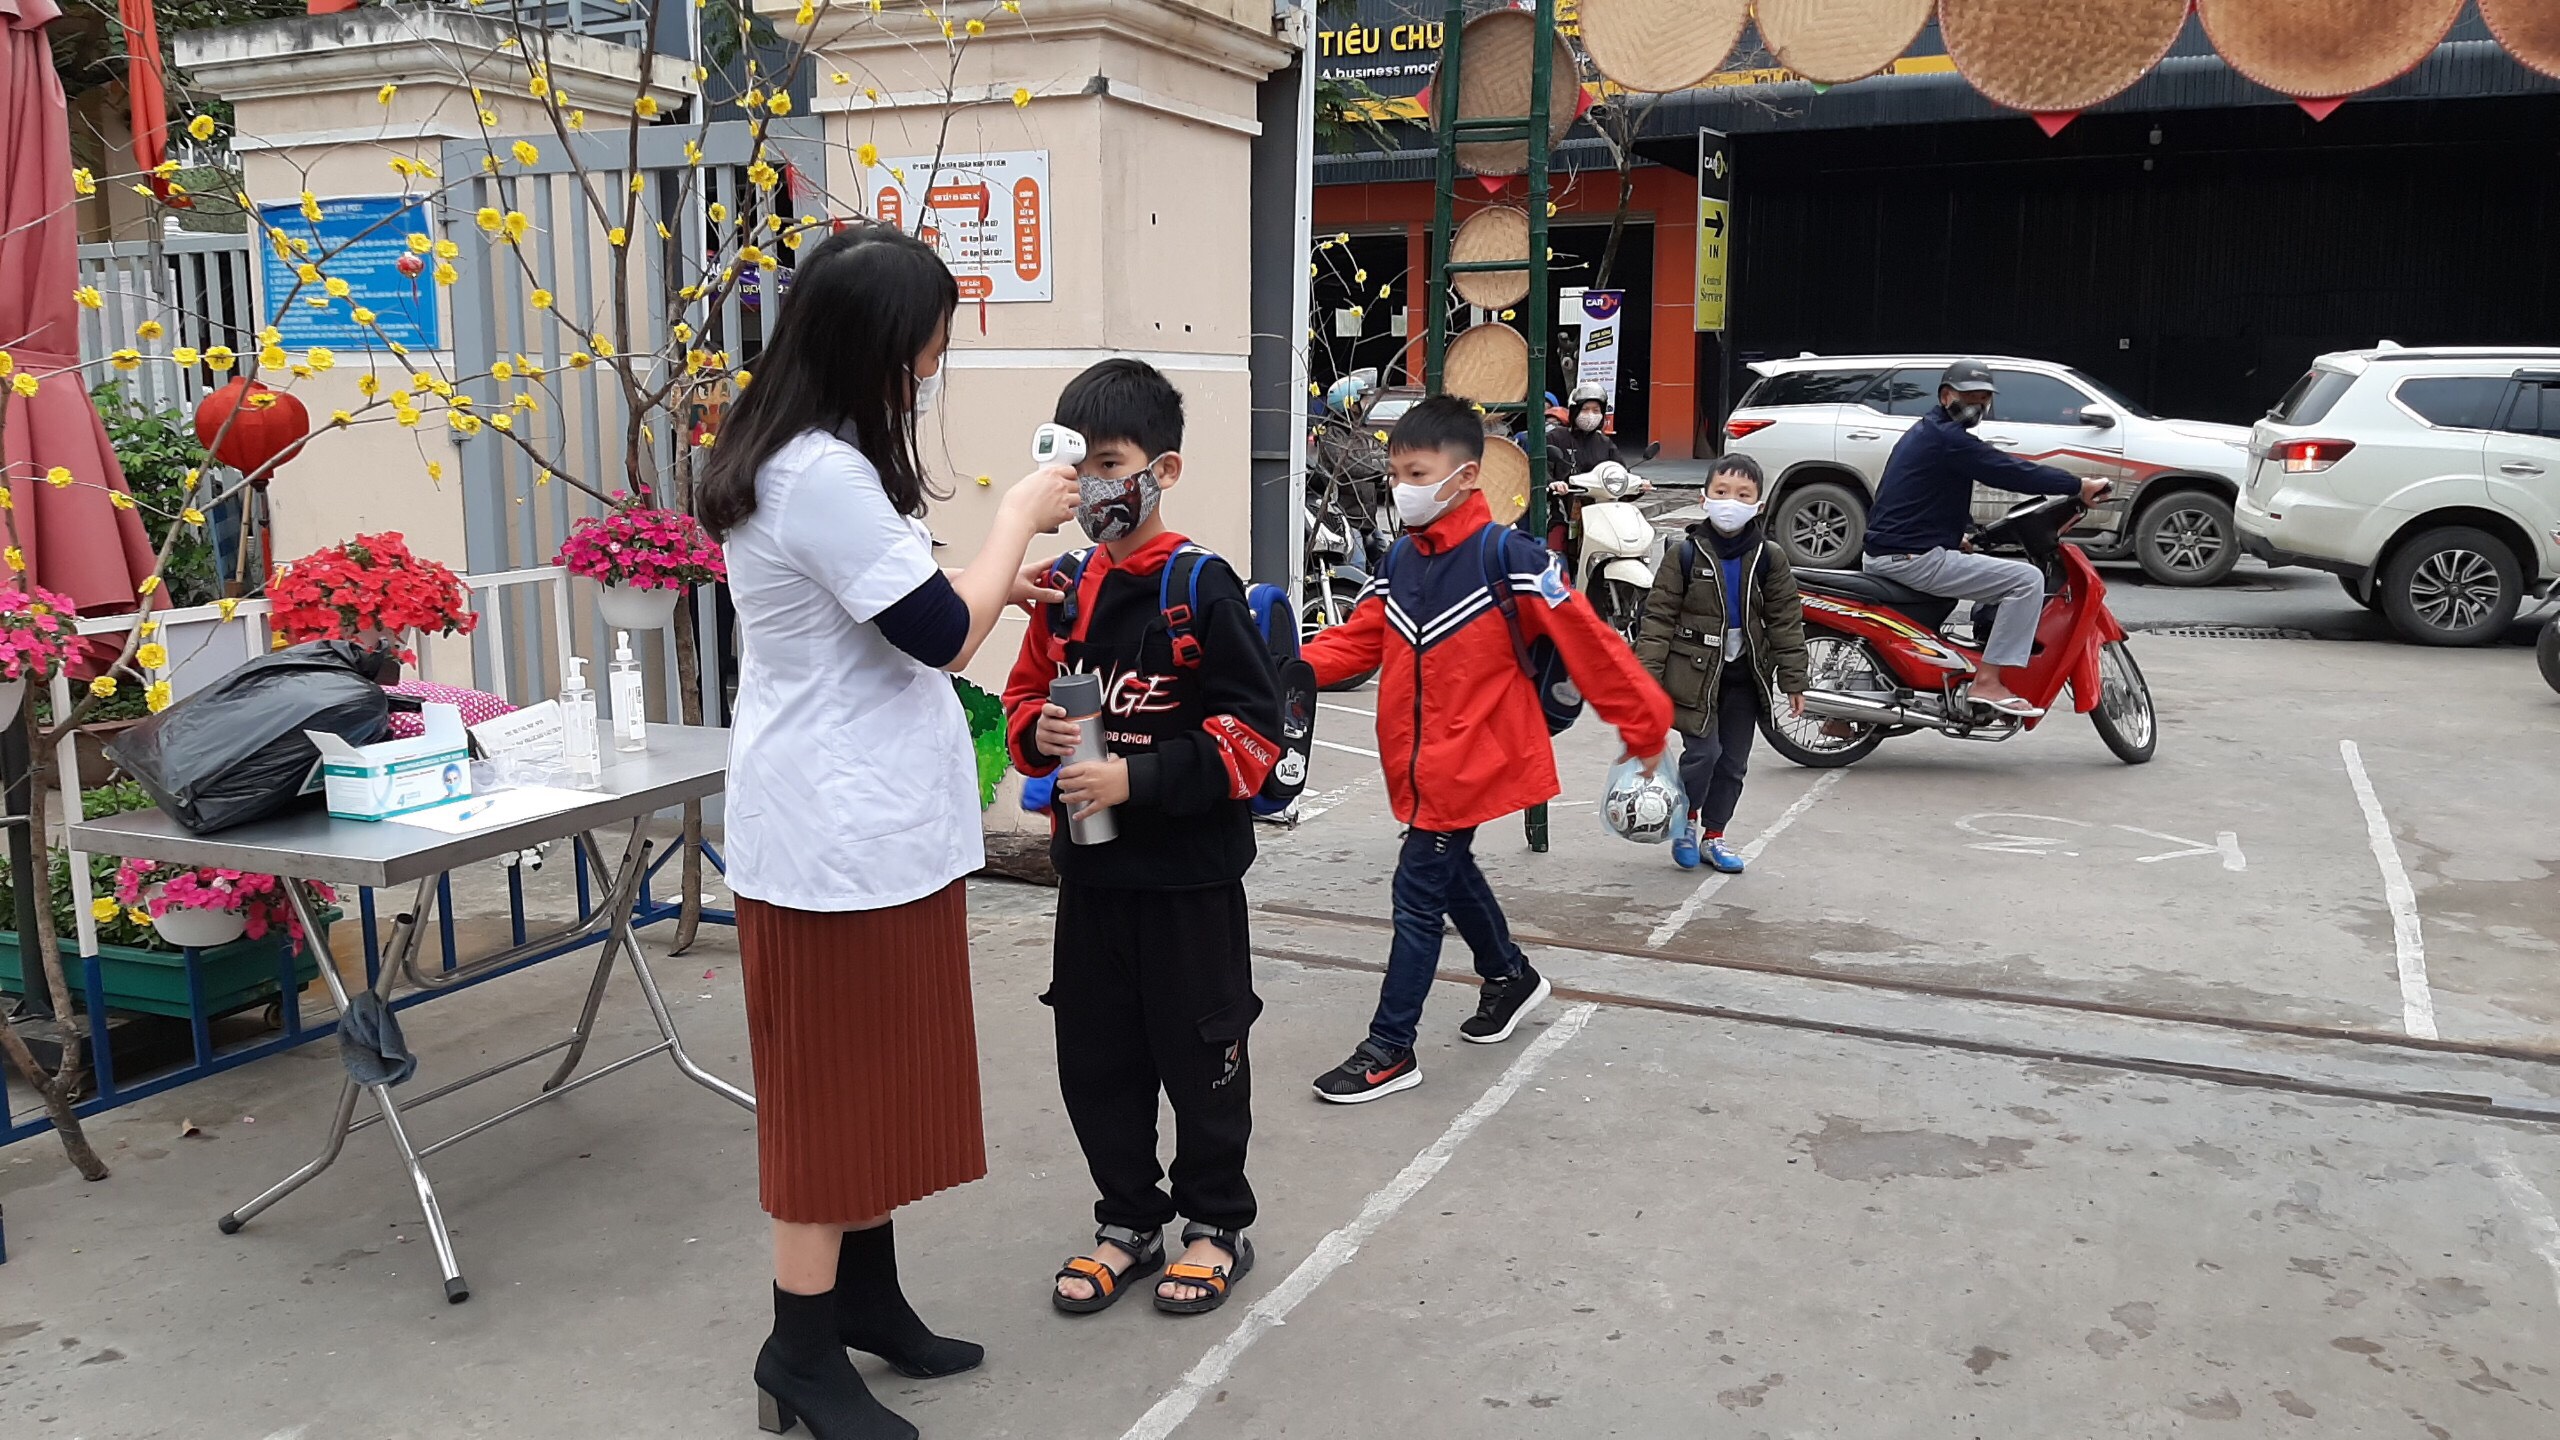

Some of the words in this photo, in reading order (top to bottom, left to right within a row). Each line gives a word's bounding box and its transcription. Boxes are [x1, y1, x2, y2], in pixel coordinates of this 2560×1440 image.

[1318, 22, 1380, 56] TIÊU
[1336, 65, 1401, 79] business
[1709, 244, 1720, 259] IN
[1700, 288, 1723, 303] Service
[1121, 732, 1152, 745] QHGM
[1240, 735, 1272, 766] MUSIC
